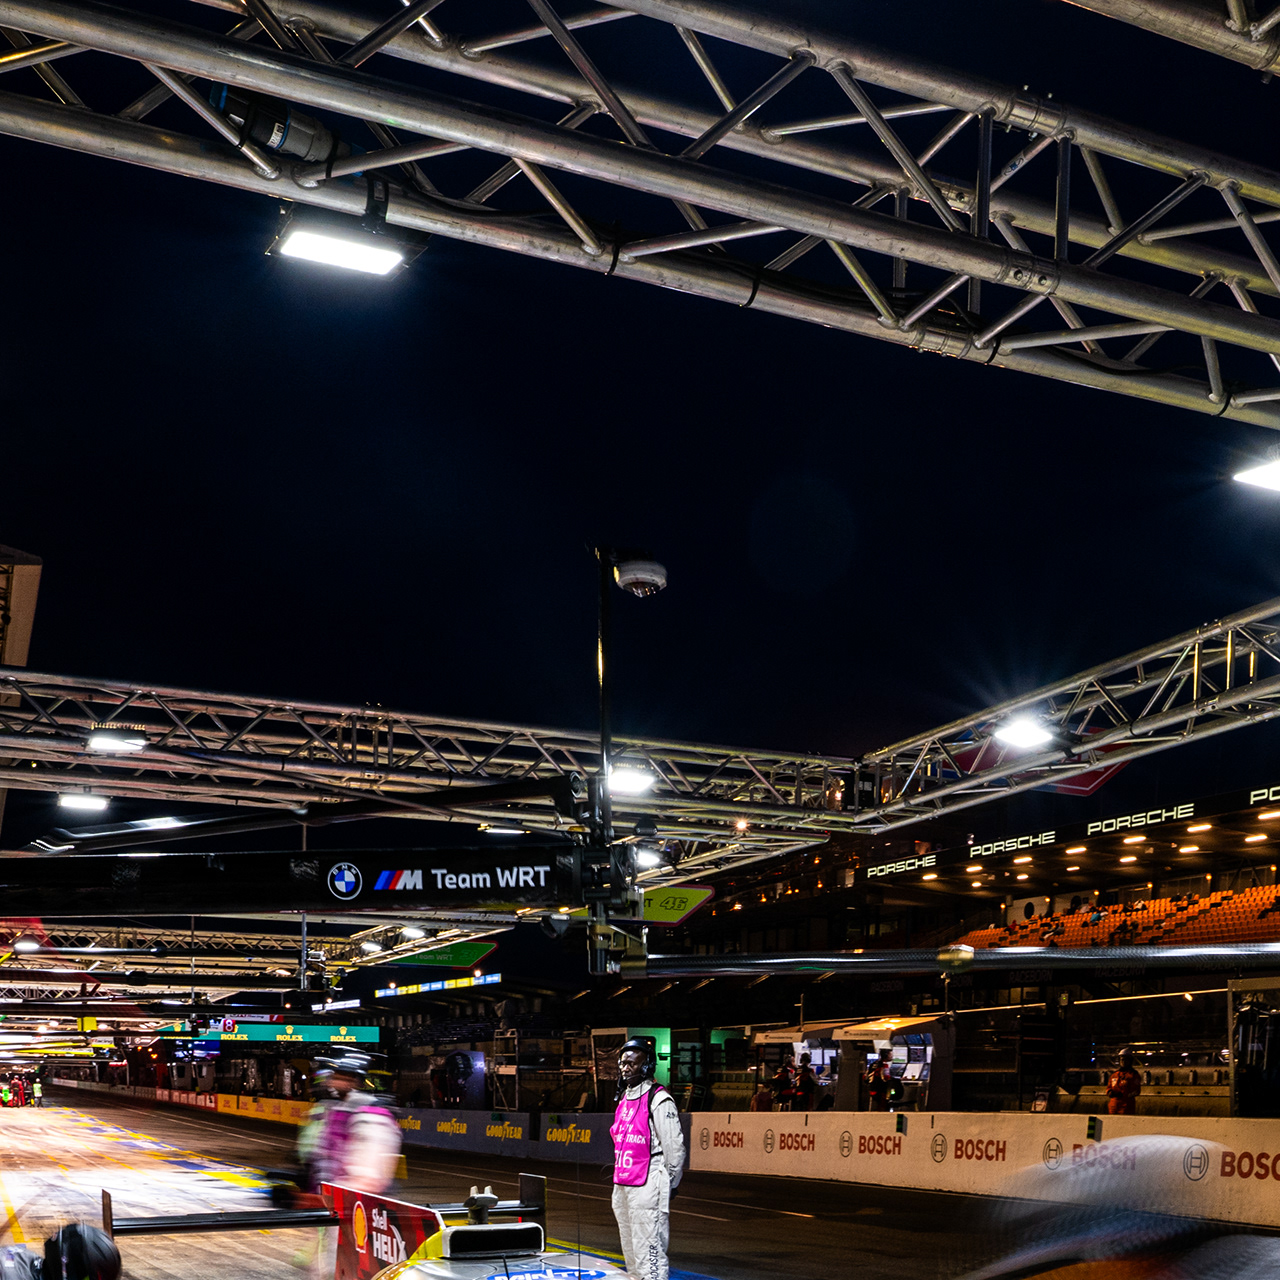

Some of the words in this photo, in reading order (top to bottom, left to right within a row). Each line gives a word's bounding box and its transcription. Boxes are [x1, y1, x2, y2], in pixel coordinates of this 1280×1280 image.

[1087, 803, 1195, 836] PORSCHE
[970, 831, 1056, 858] PORSCHE
[431, 868, 492, 889] Team
[495, 865, 551, 888] WRT
[867, 855, 937, 879] PORSCHE
[659, 896, 688, 911] 46
[1009, 968, 1052, 985] RACEBORN
[225, 1019, 234, 1032] 8
[220, 1033, 249, 1041] ROLEX
[276, 1034, 304, 1042] ROLEX
[436, 1117, 468, 1136] GOODYEAR
[486, 1121, 522, 1142] GOODYEAR
[546, 1123, 592, 1147] GOODYEAR
[625, 1133, 647, 1145] TRACK
[713, 1131, 744, 1149] BOSCH
[779, 1133, 816, 1152] BOSCH
[858, 1135, 902, 1156] BOSCH
[954, 1138, 1007, 1162] BOSCH
[1072, 1143, 1137, 1171] BOSCH
[371, 1207, 388, 1231] Shell
[372, 1230, 407, 1264] HELIX
